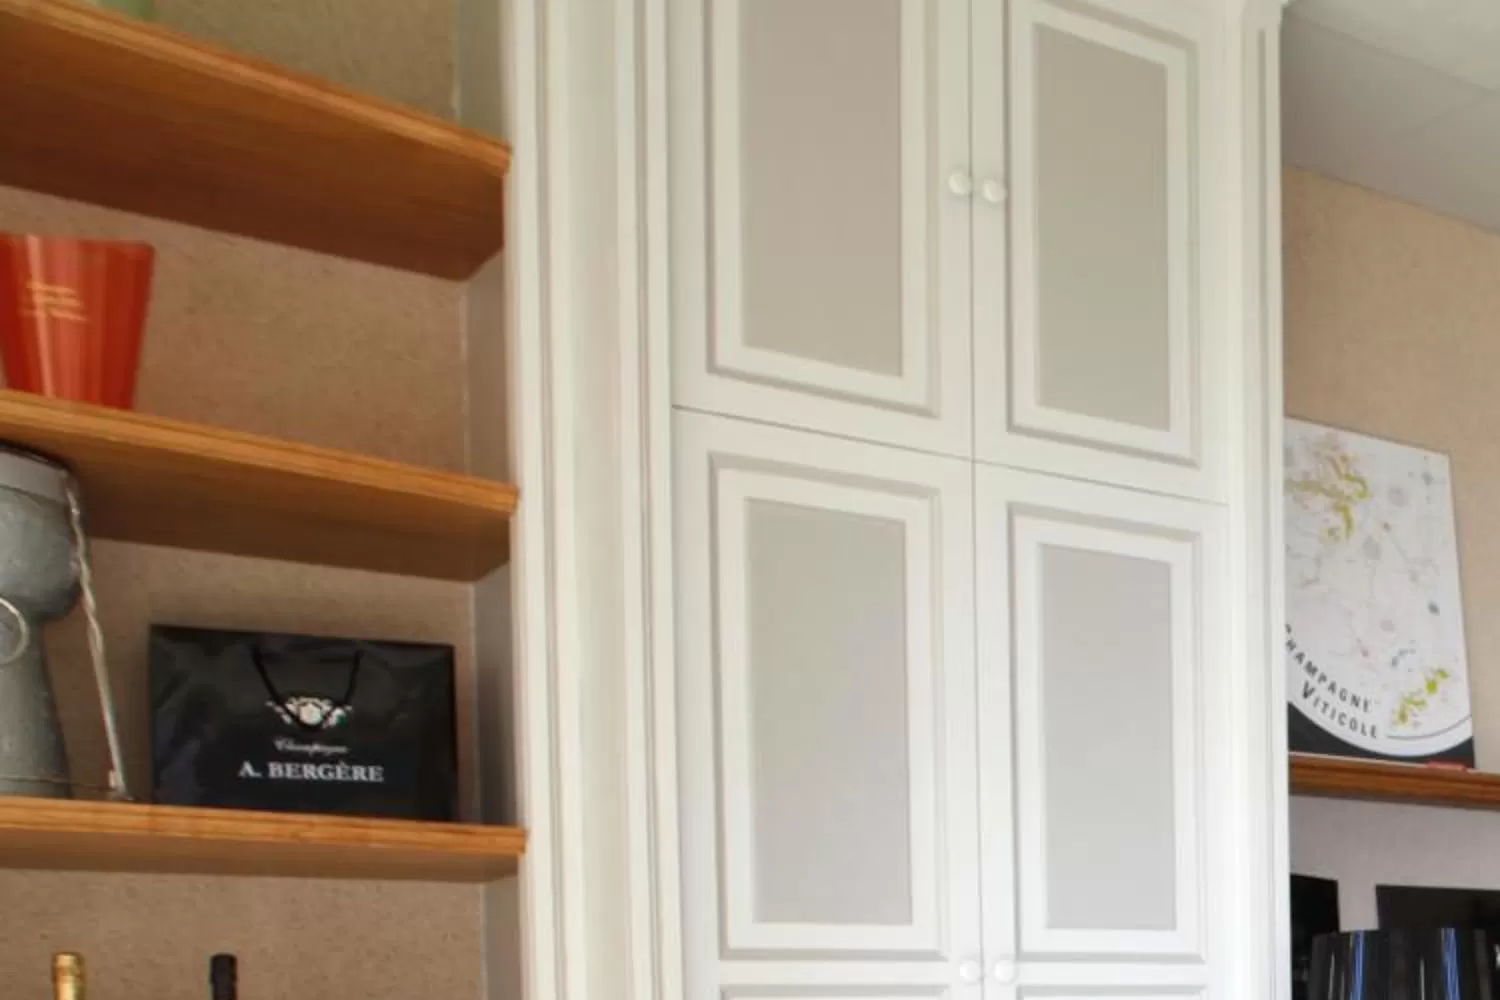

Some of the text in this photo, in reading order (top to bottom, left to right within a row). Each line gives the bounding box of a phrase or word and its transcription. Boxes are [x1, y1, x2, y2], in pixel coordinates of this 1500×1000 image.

[1302, 679, 1378, 739] VITICOLE
[238, 759, 384, 782] A. BERGÈRE
